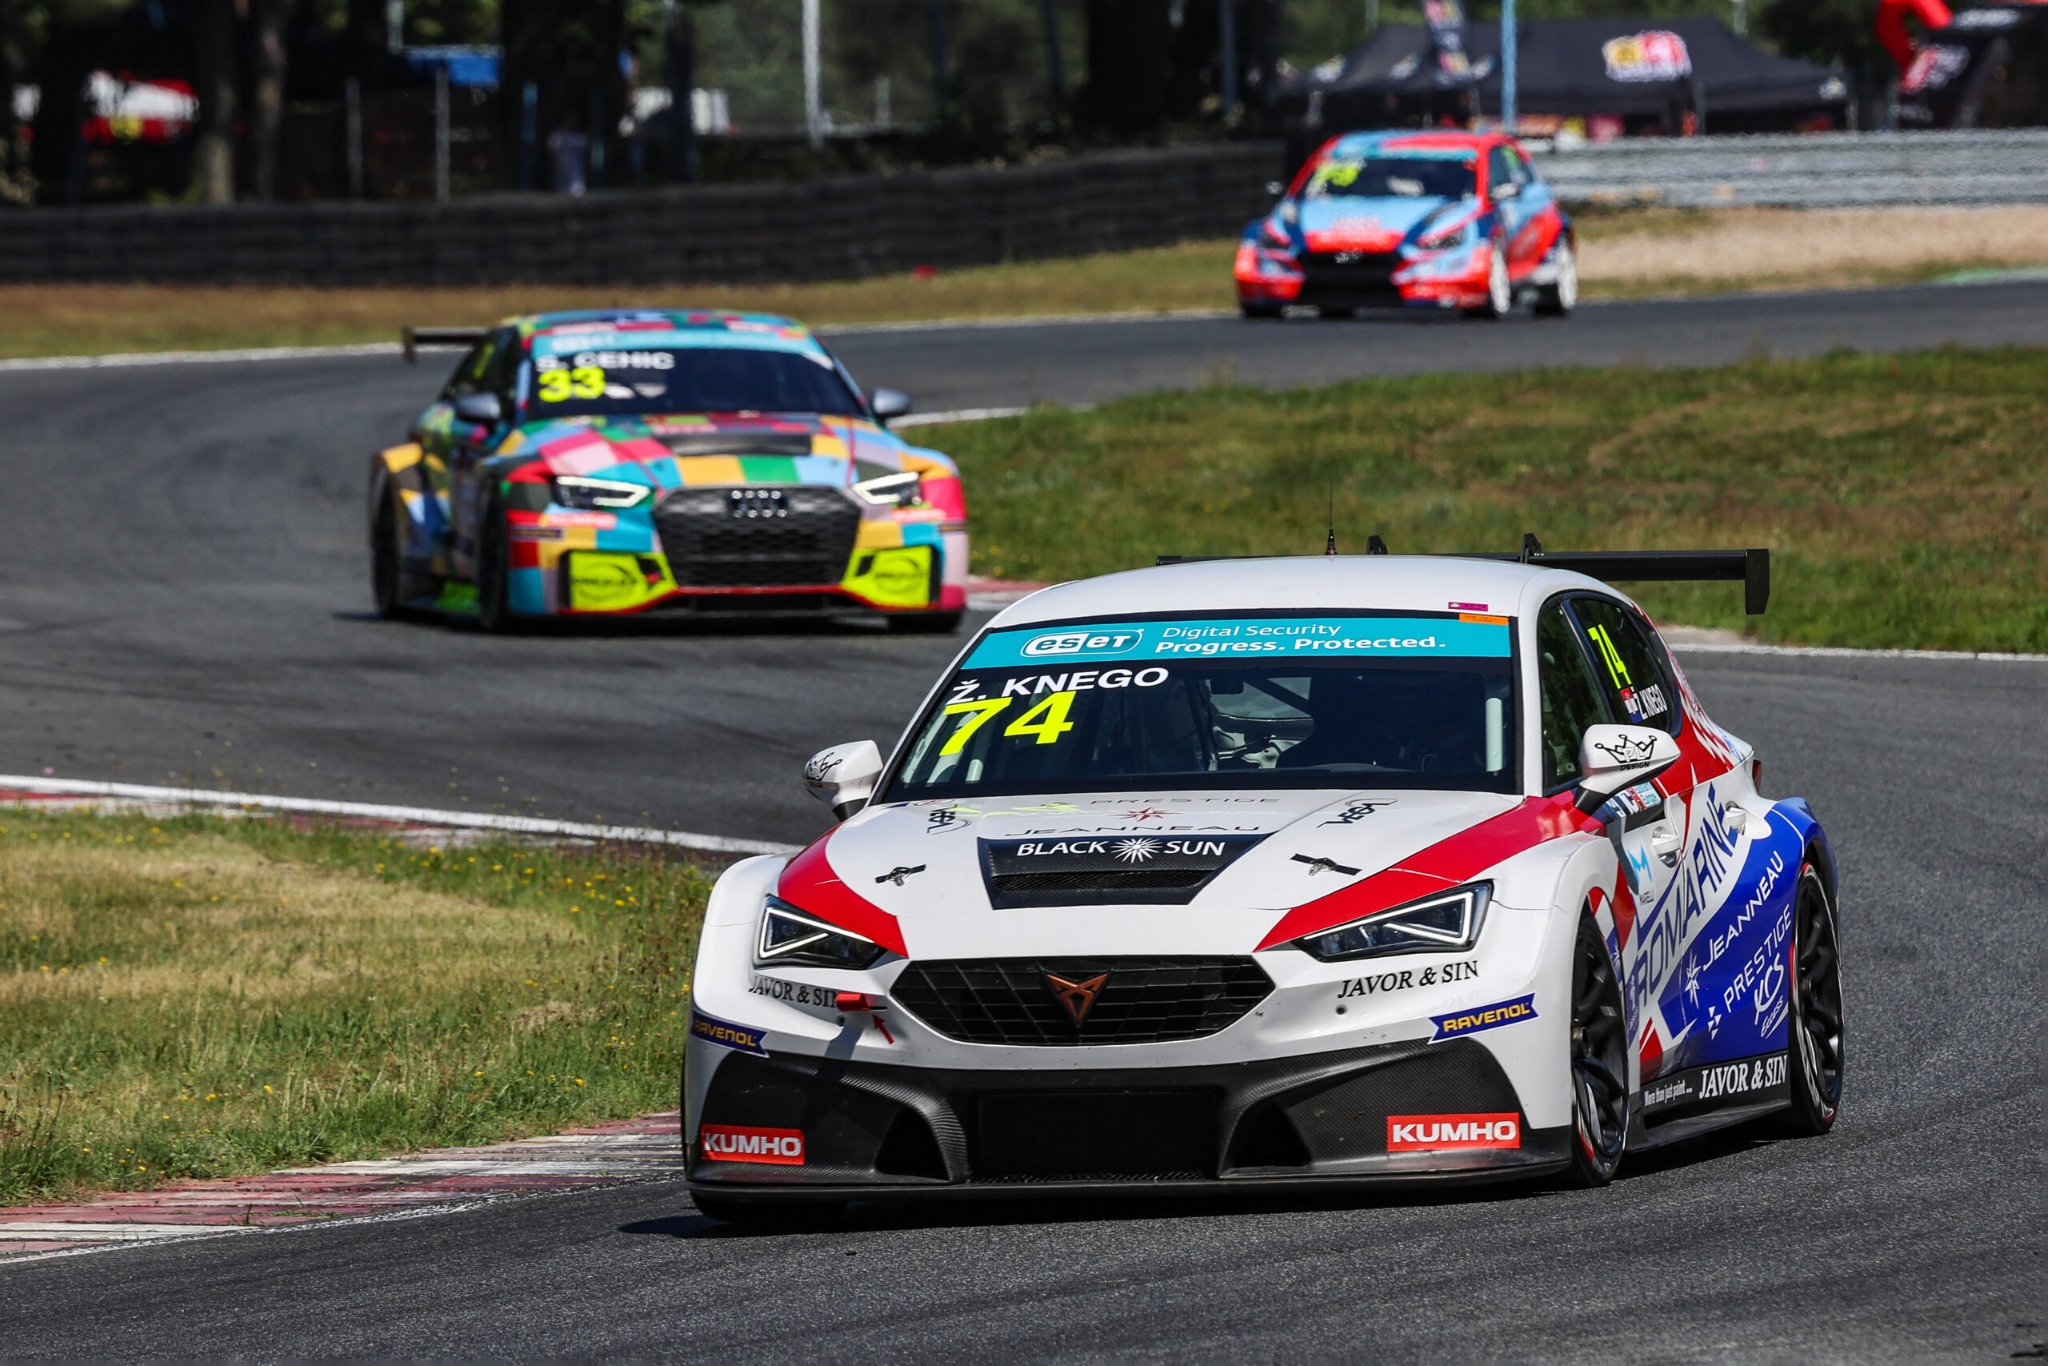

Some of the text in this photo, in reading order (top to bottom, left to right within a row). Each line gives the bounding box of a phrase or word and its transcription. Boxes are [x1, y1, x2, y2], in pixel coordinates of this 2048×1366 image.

[538, 366, 606, 402] 33
[1155, 635, 1447, 655] Progress. Protected.
[1162, 623, 1342, 641] Digital Security
[1587, 623, 1633, 690] 74
[1000, 667, 1170, 697] KNEGO
[1638, 683, 1669, 718] KNEGO
[938, 690, 1077, 757] 74
[1004, 825, 1261, 837] JEANNEAU
[1016, 839, 1226, 857] BLACK SUN
[1702, 850, 1784, 973] JEANNEAU
[1723, 904, 1793, 1014] PRESTIGE
[748, 975, 795, 1002] JAVOR
[796, 985, 811, 1005] &
[1337, 960, 1480, 999] JAVOR & SIN
[1442, 1002, 1531, 1033] RAVENOL
[1698, 1054, 1788, 1100] JAVOR & SIN
[703, 1132, 802, 1158] KUMHO
[1391, 1120, 1518, 1144] KUMHO
